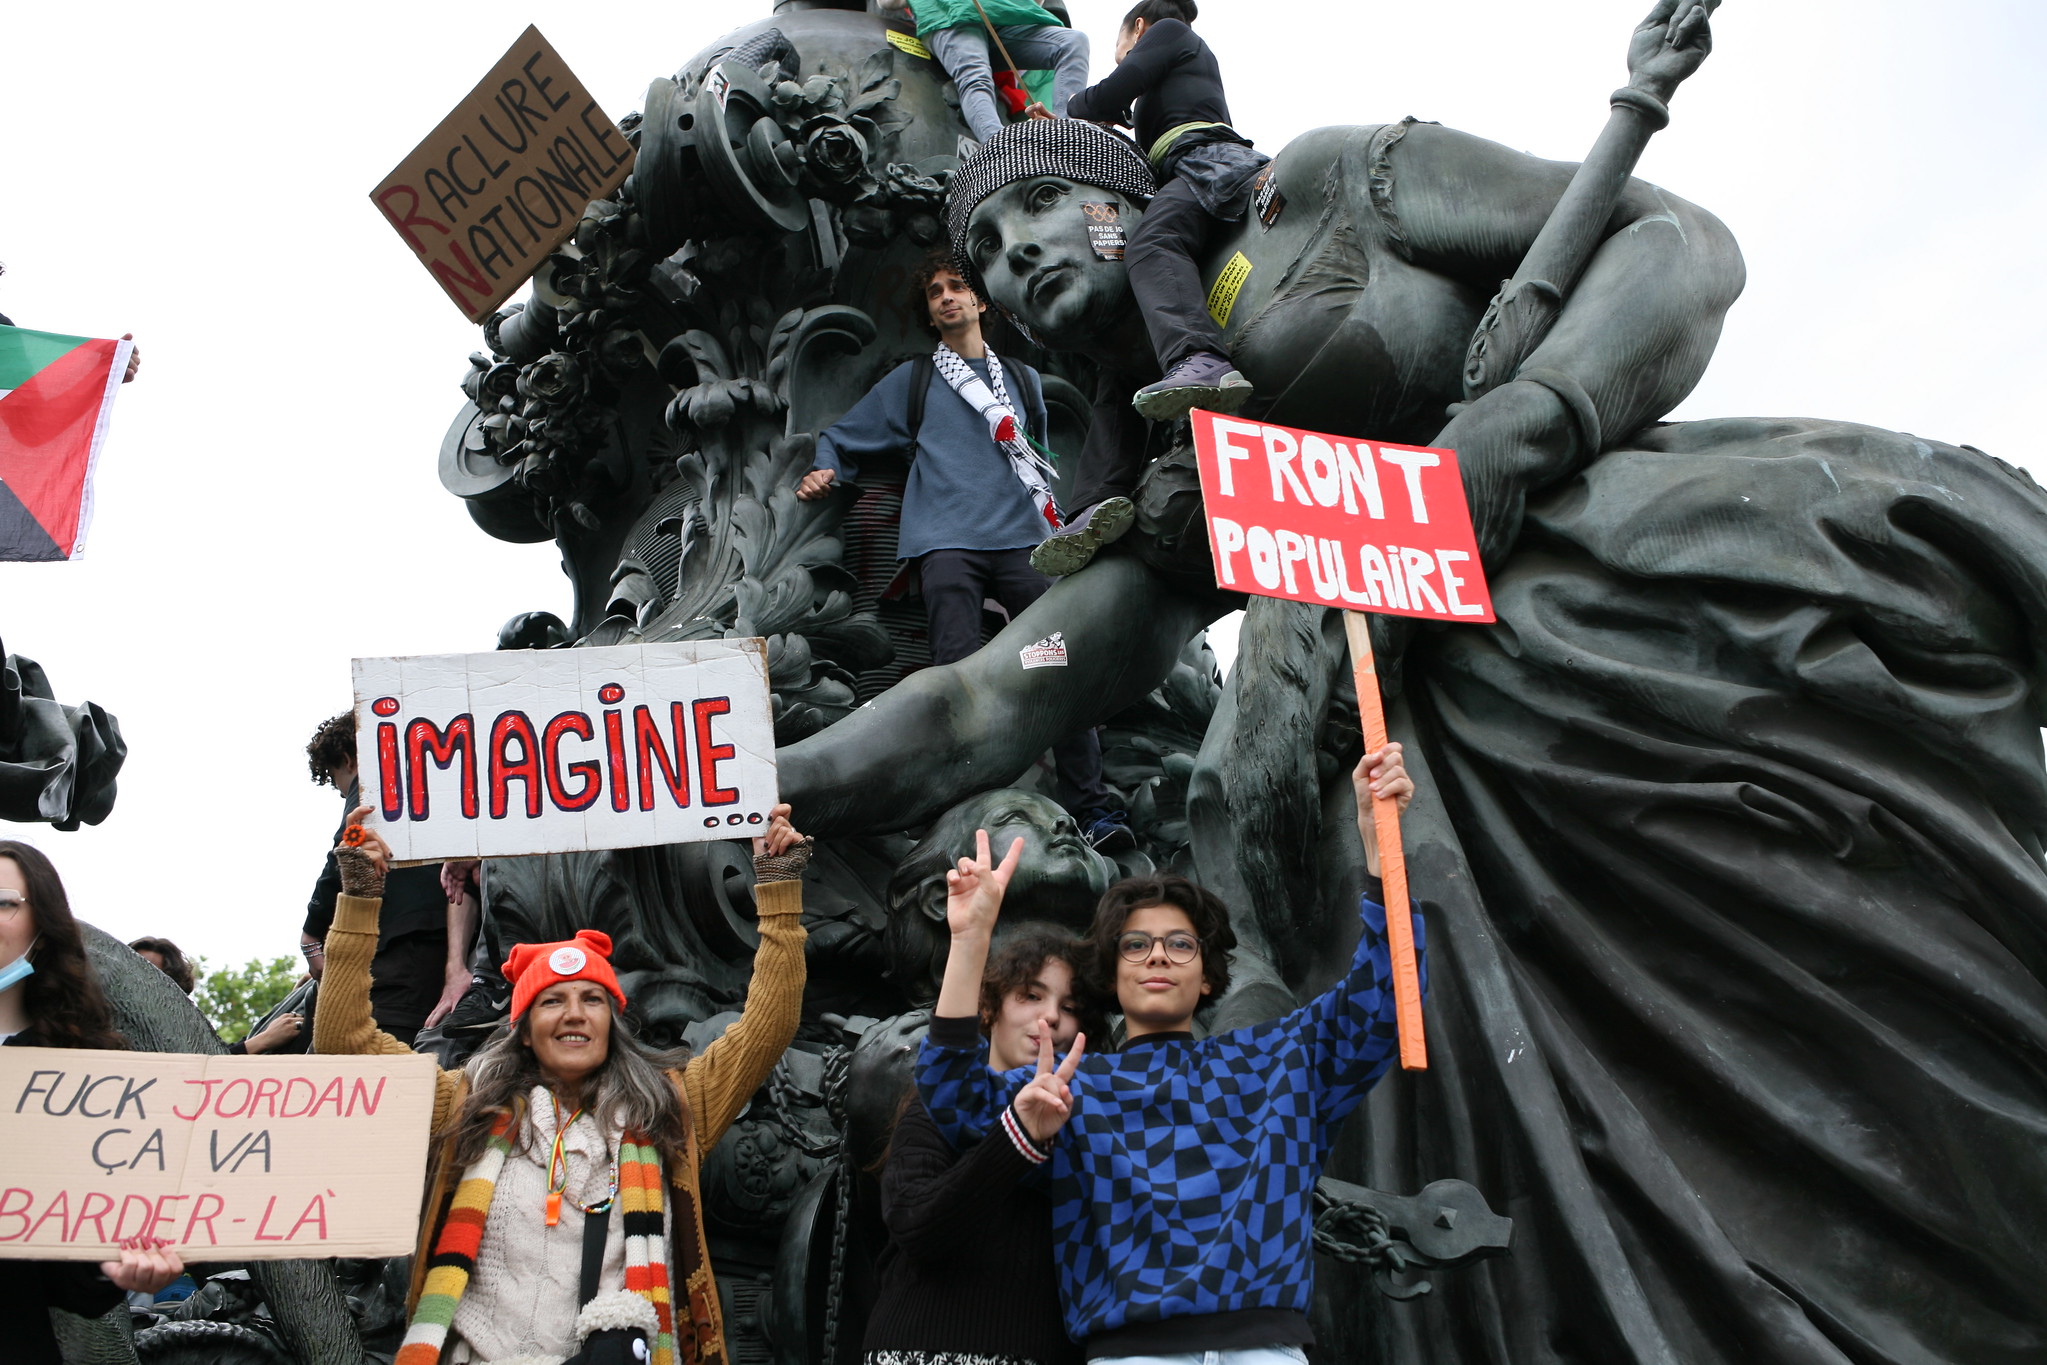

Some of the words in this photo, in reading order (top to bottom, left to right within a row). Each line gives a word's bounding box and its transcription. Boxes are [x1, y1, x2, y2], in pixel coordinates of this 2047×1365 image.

[378, 51, 571, 254] RACLURE
[430, 101, 631, 315] NATIONALE
[1217, 286, 1232, 317] BOYCOTT
[1230, 265, 1244, 286] ISRAEL
[1219, 285, 1226, 295] UN
[1225, 263, 1238, 283] SPORT
[1221, 307, 1229, 322] AUX
[1227, 293, 1233, 306] JO
[1212, 417, 1440, 524] FRONT
[1024, 650, 1056, 660] STOPPONS
[15, 1070, 158, 1120] FUCK
[172, 1076, 388, 1121] JORDAN
[92, 1128, 166, 1175] ÇA
[209, 1129, 272, 1173] VA
